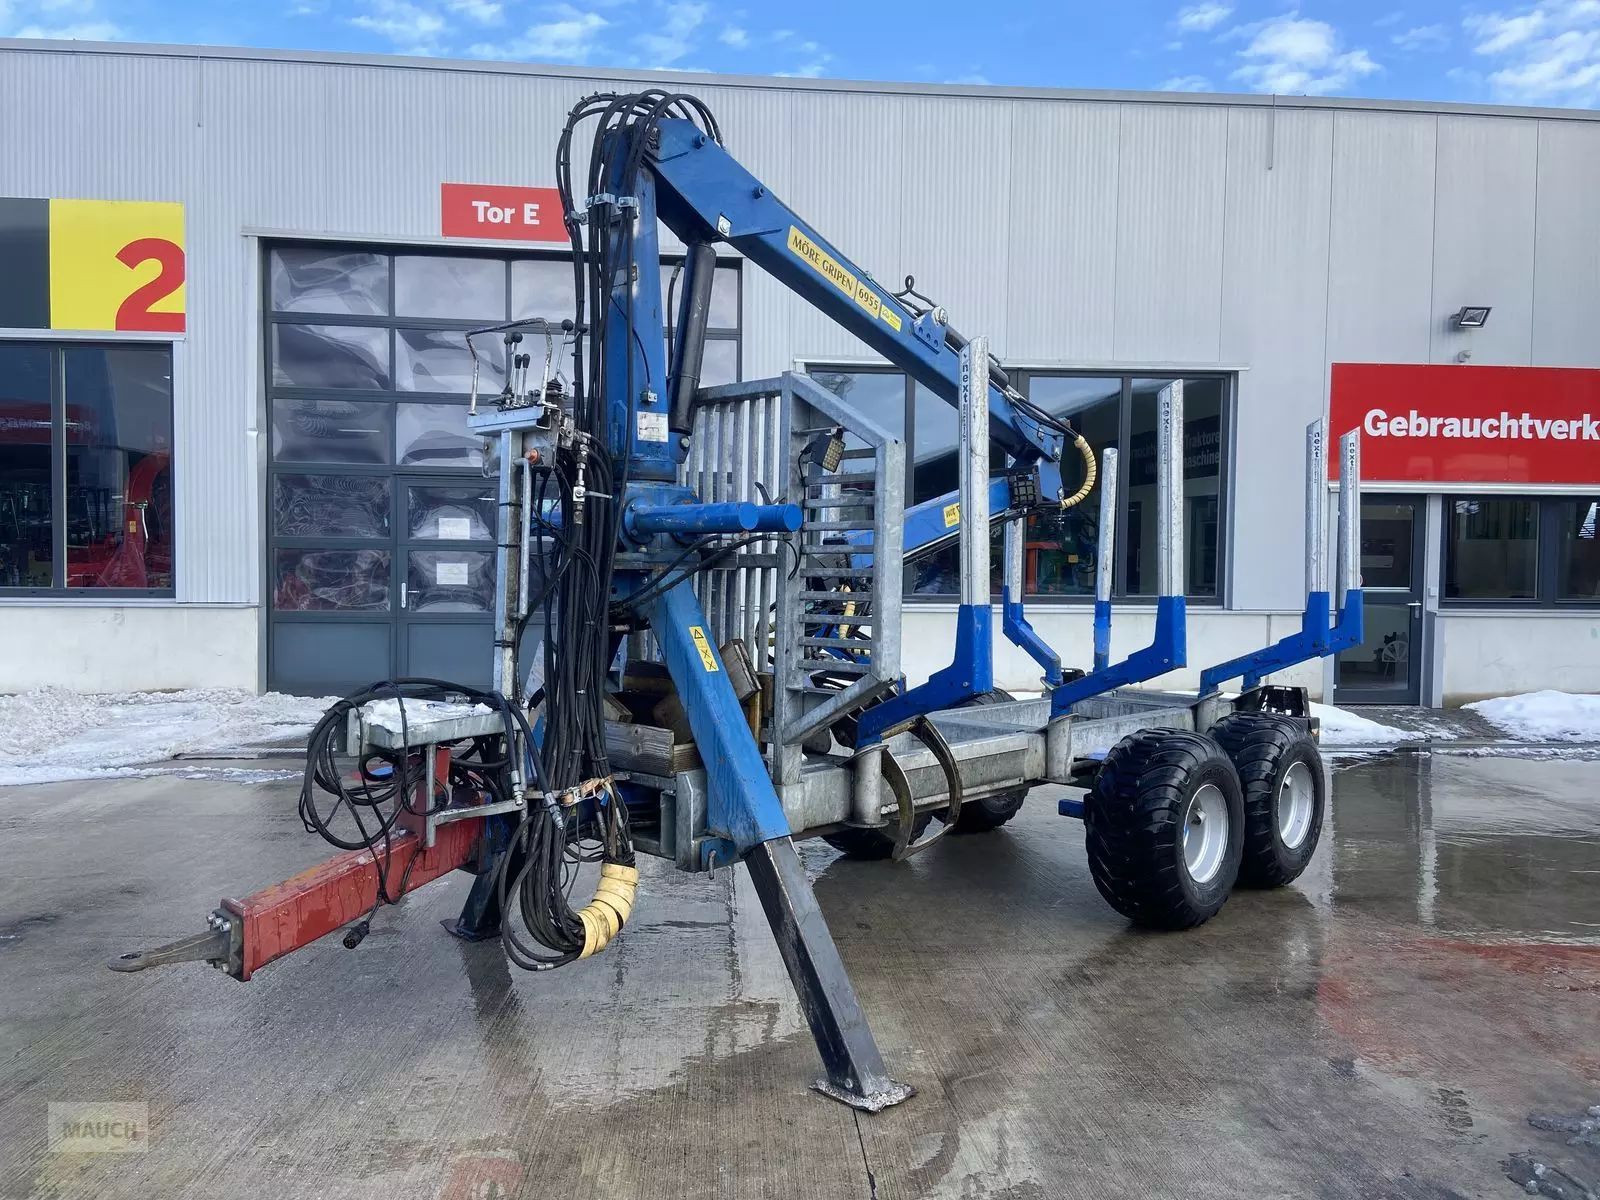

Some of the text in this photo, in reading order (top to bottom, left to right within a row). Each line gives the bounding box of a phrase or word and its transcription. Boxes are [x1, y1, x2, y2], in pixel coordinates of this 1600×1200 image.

[472, 200, 540, 225] Tor E
[792, 235, 853, 291] MÖRE GRIPEN
[115, 238, 186, 332] 2
[858, 288, 879, 311] 6955
[1364, 408, 1600, 441] Gebrauchtverk
